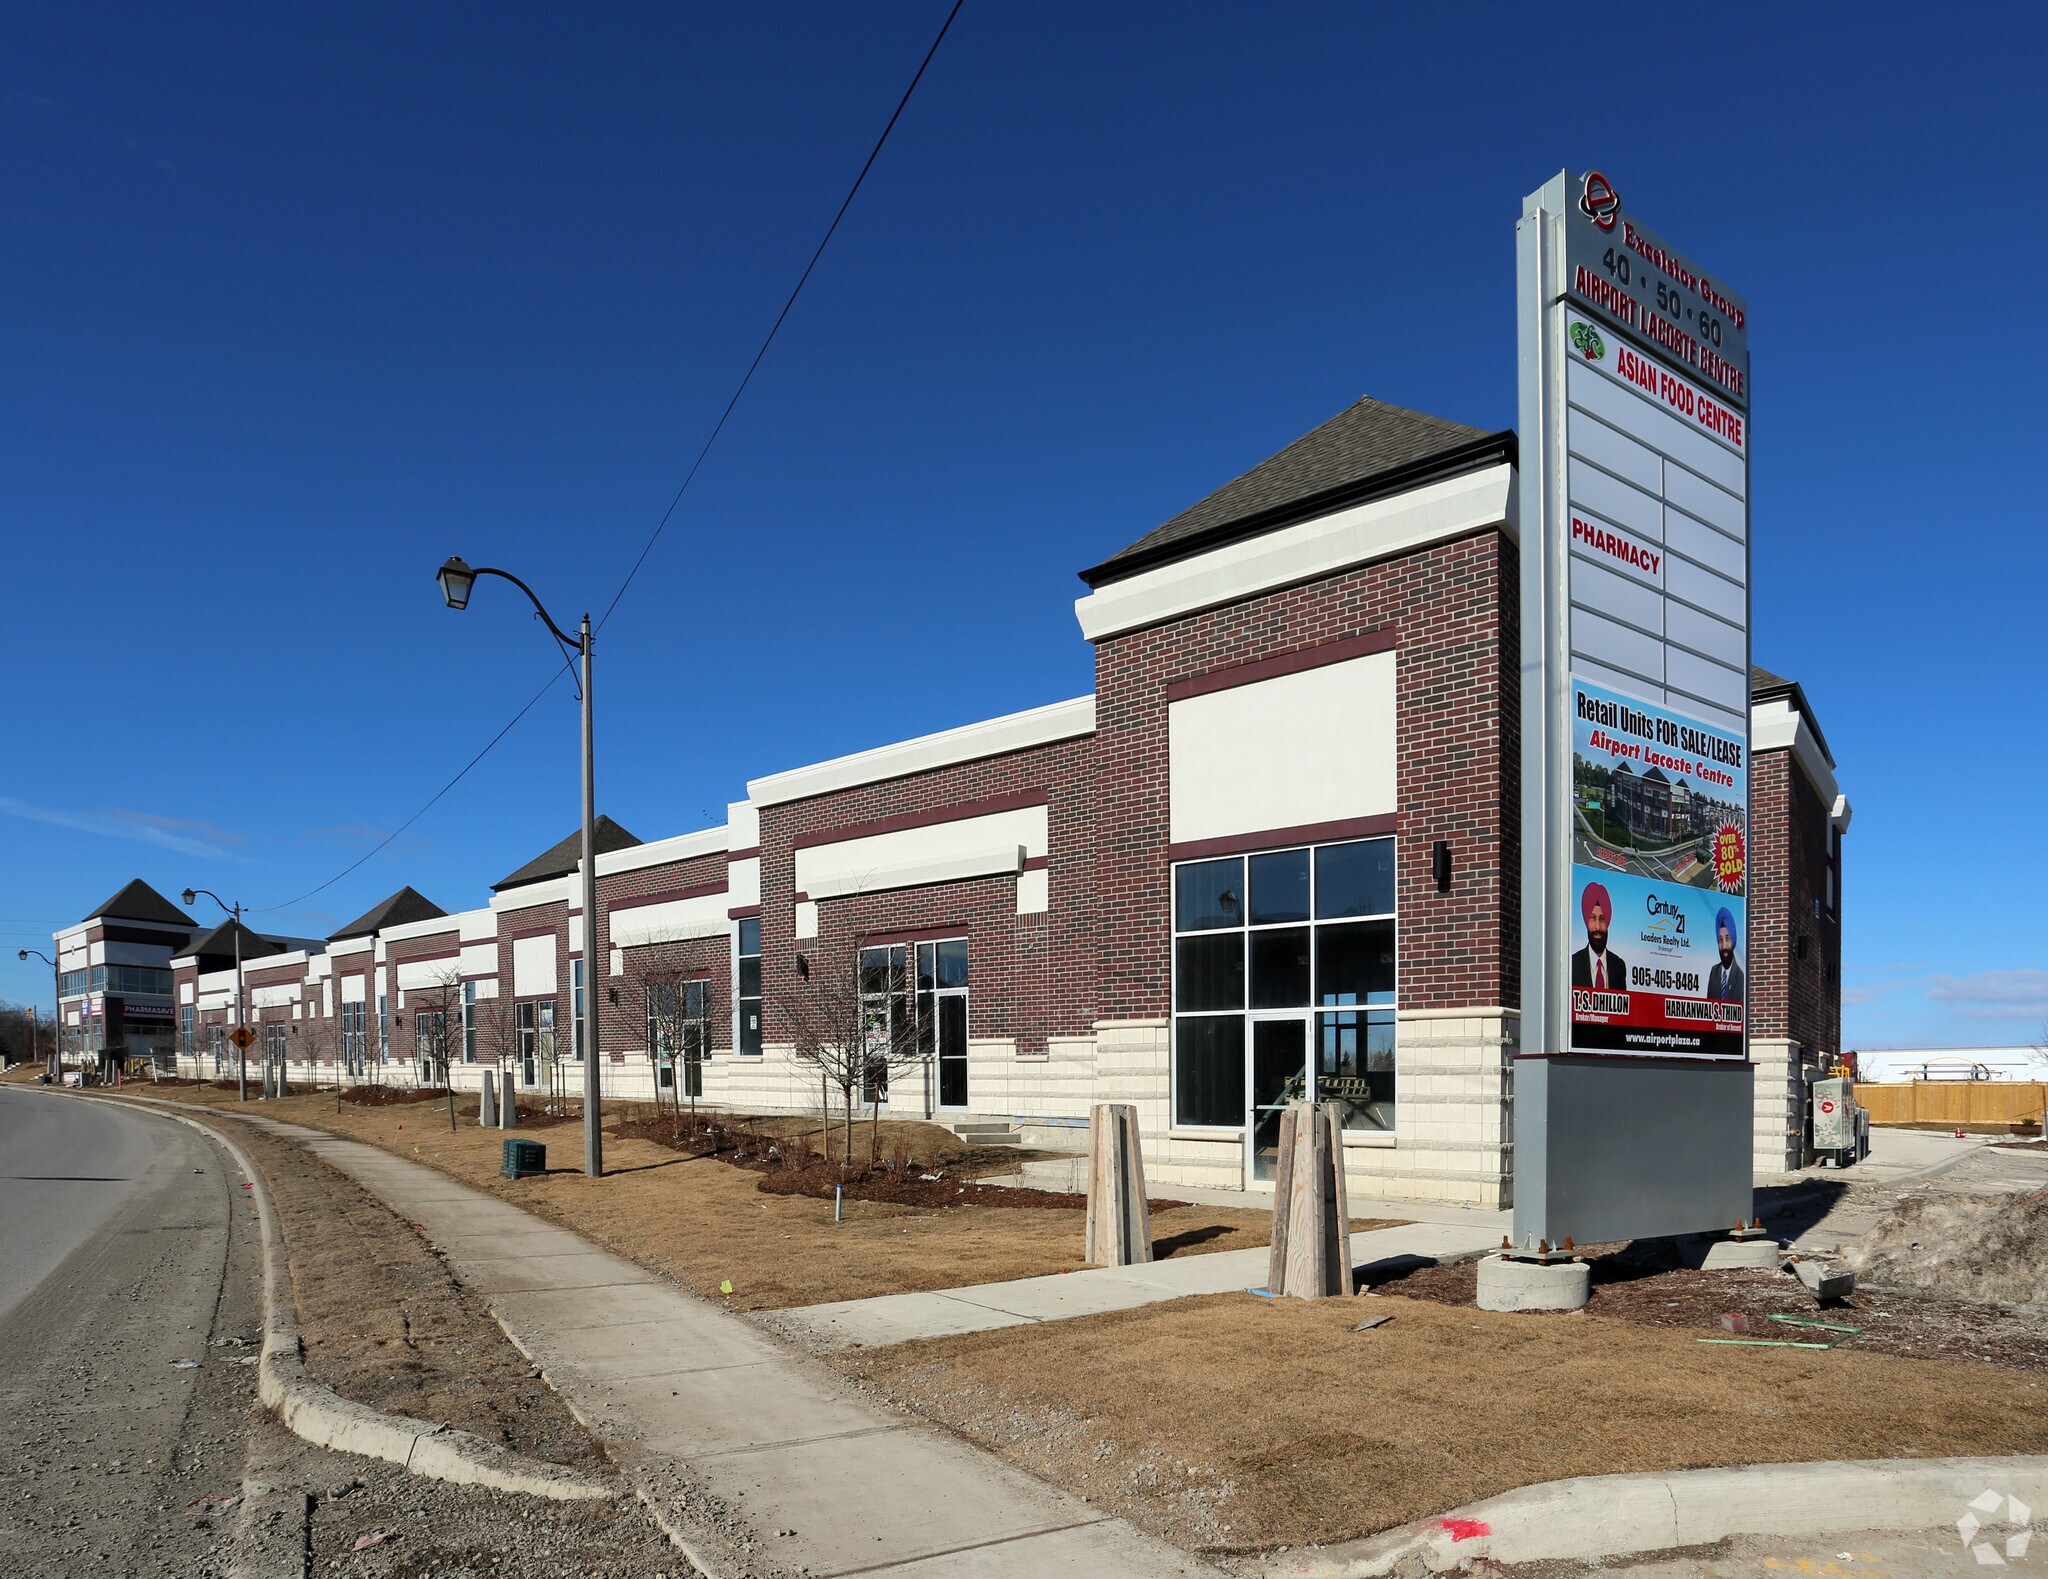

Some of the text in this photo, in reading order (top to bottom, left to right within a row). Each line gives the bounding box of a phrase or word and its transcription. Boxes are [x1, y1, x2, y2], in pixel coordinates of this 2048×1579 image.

[1622, 221, 1745, 330] Excelsior Group
[1603, 247, 1722, 349] 40 50 60
[1575, 264, 1744, 396] AIRPORT LACOSTE CENTRE
[1618, 347, 1742, 446] ASIAN FOOD CENTRE
[1573, 517, 1660, 575] PHARMACY
[1577, 691, 1742, 768] Retail Units FOR SALE/LEASE
[1590, 730, 1733, 787] Airport Lacoste Centre
[1720, 834, 1736, 845] OVER
[1721, 845, 1740, 860] 80%
[1720, 859, 1743, 876] SOLD
[1647, 894, 1679, 919] Century
[1675, 913, 1685, 934] 21
[1641, 931, 1662, 944] Leaders
[1663, 935, 1679, 948] Realty
[1631, 966, 1700, 991] 905-405-8484
[124, 1005, 175, 1015] PHARMASAVE
[1573, 991, 1629, 1013] T. S. DHILLON
[1665, 1000, 1742, 1022] HARKANWAL S. THIND
[1625, 1033, 1700, 1047] www.airportplaza.ca
